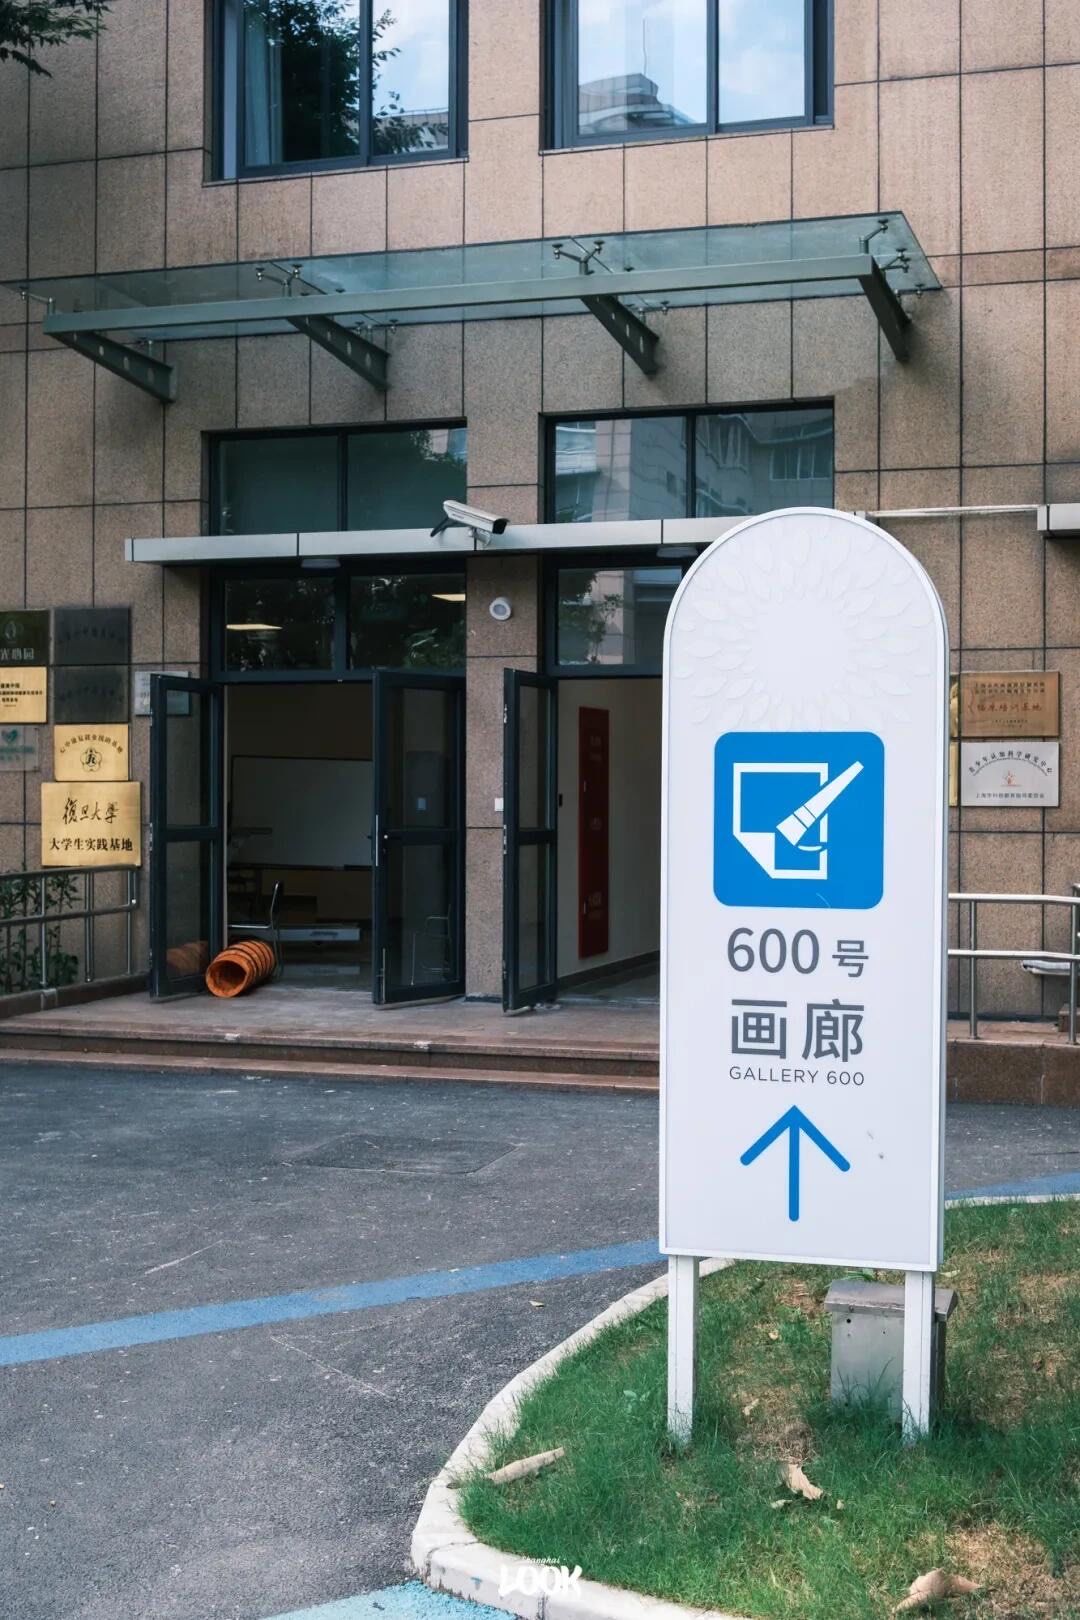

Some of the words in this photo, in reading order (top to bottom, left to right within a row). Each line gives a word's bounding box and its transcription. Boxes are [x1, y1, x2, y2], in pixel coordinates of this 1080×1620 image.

[49, 837, 133, 851] 大学生实践基地
[731, 998, 865, 1063] 画廊
[729, 1066, 819, 1084] GALLERY
[827, 1070, 865, 1086] 600
